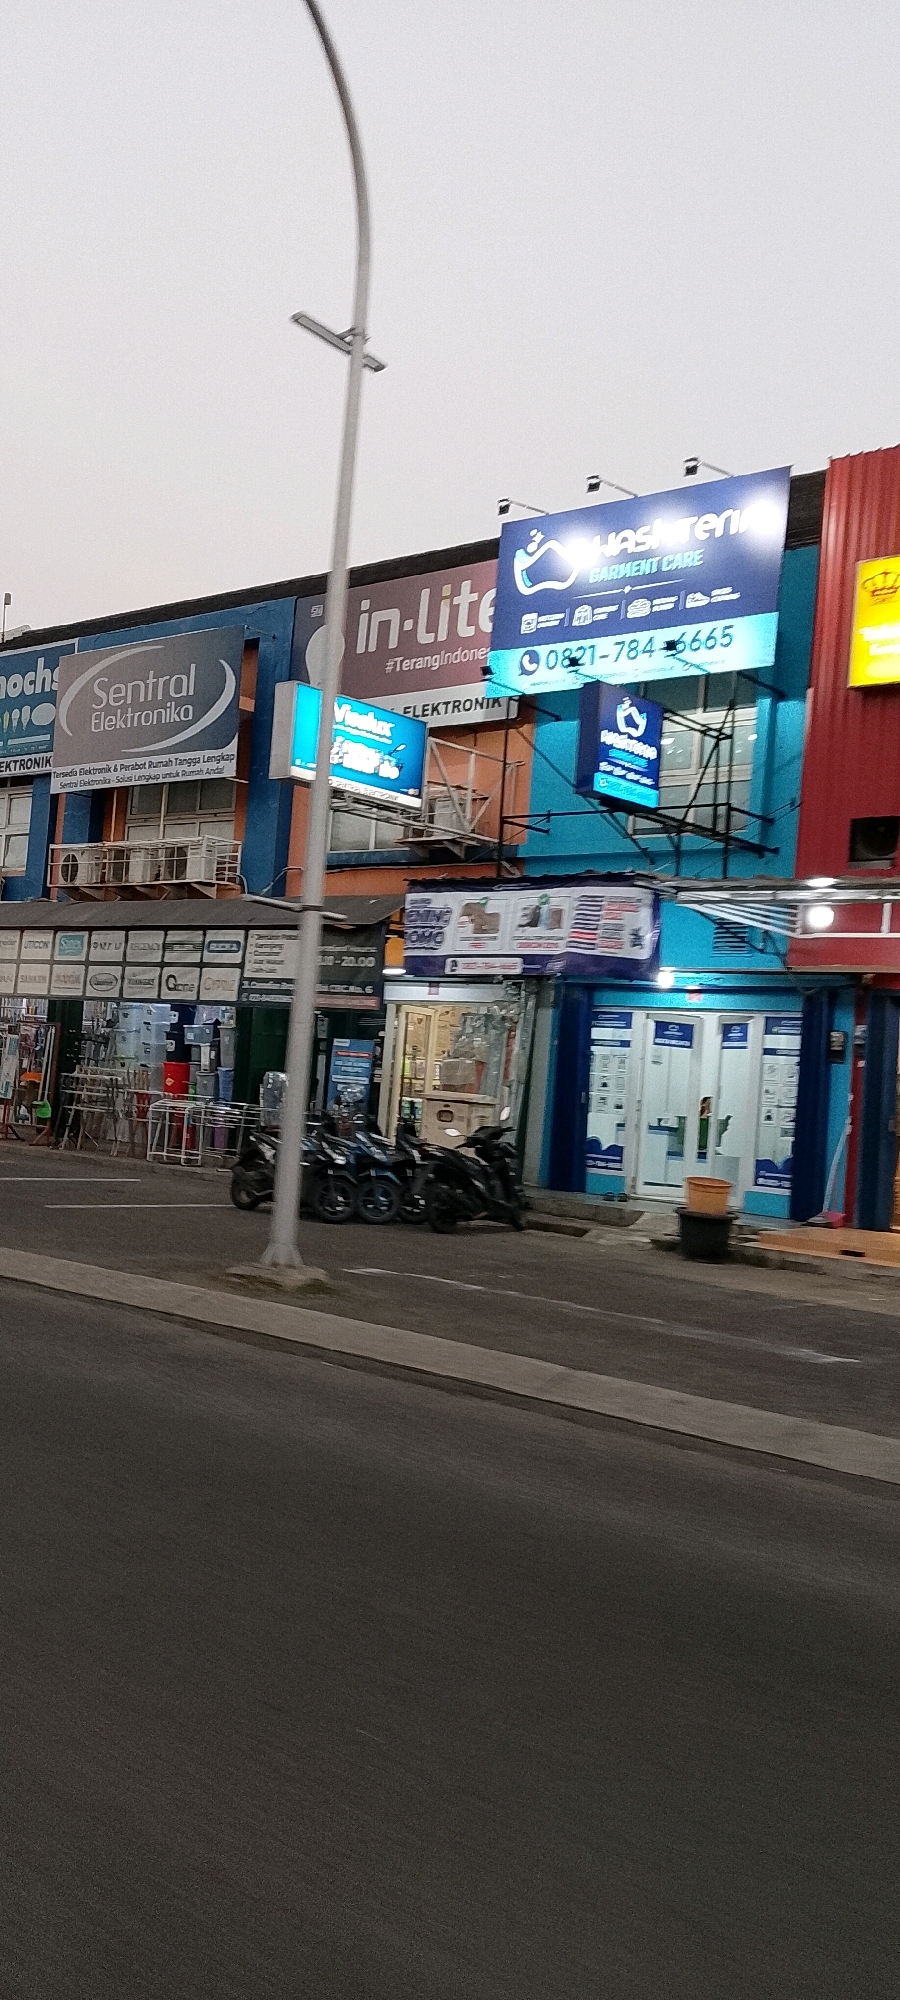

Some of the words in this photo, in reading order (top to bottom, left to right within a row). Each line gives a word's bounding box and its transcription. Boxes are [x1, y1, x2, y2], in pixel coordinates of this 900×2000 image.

[588, 557, 659, 583] GARMENT
[661, 549, 705, 573] CARE
[92, 663, 196, 709] Sentral
[91, 702, 193, 732] Elektronika
[53, 768, 77, 779] Tersedia
[79, 764, 112, 776] Elektronik
[113, 764, 118, 773] &
[120, 762, 146, 772] Perabot
[148, 758, 173, 769] Rumah
[174, 756, 200, 767] Tangga
[203, 752, 235, 764] Lengkap
[60, 780, 78, 789] Sentral
[79, 777, 111, 787] Elektronika
[115, 774, 132, 783] Solusi
[134, 771, 160, 783] Lengkap
[162, 770, 180, 779] untuk
[181, 768, 204, 777] Rumah
